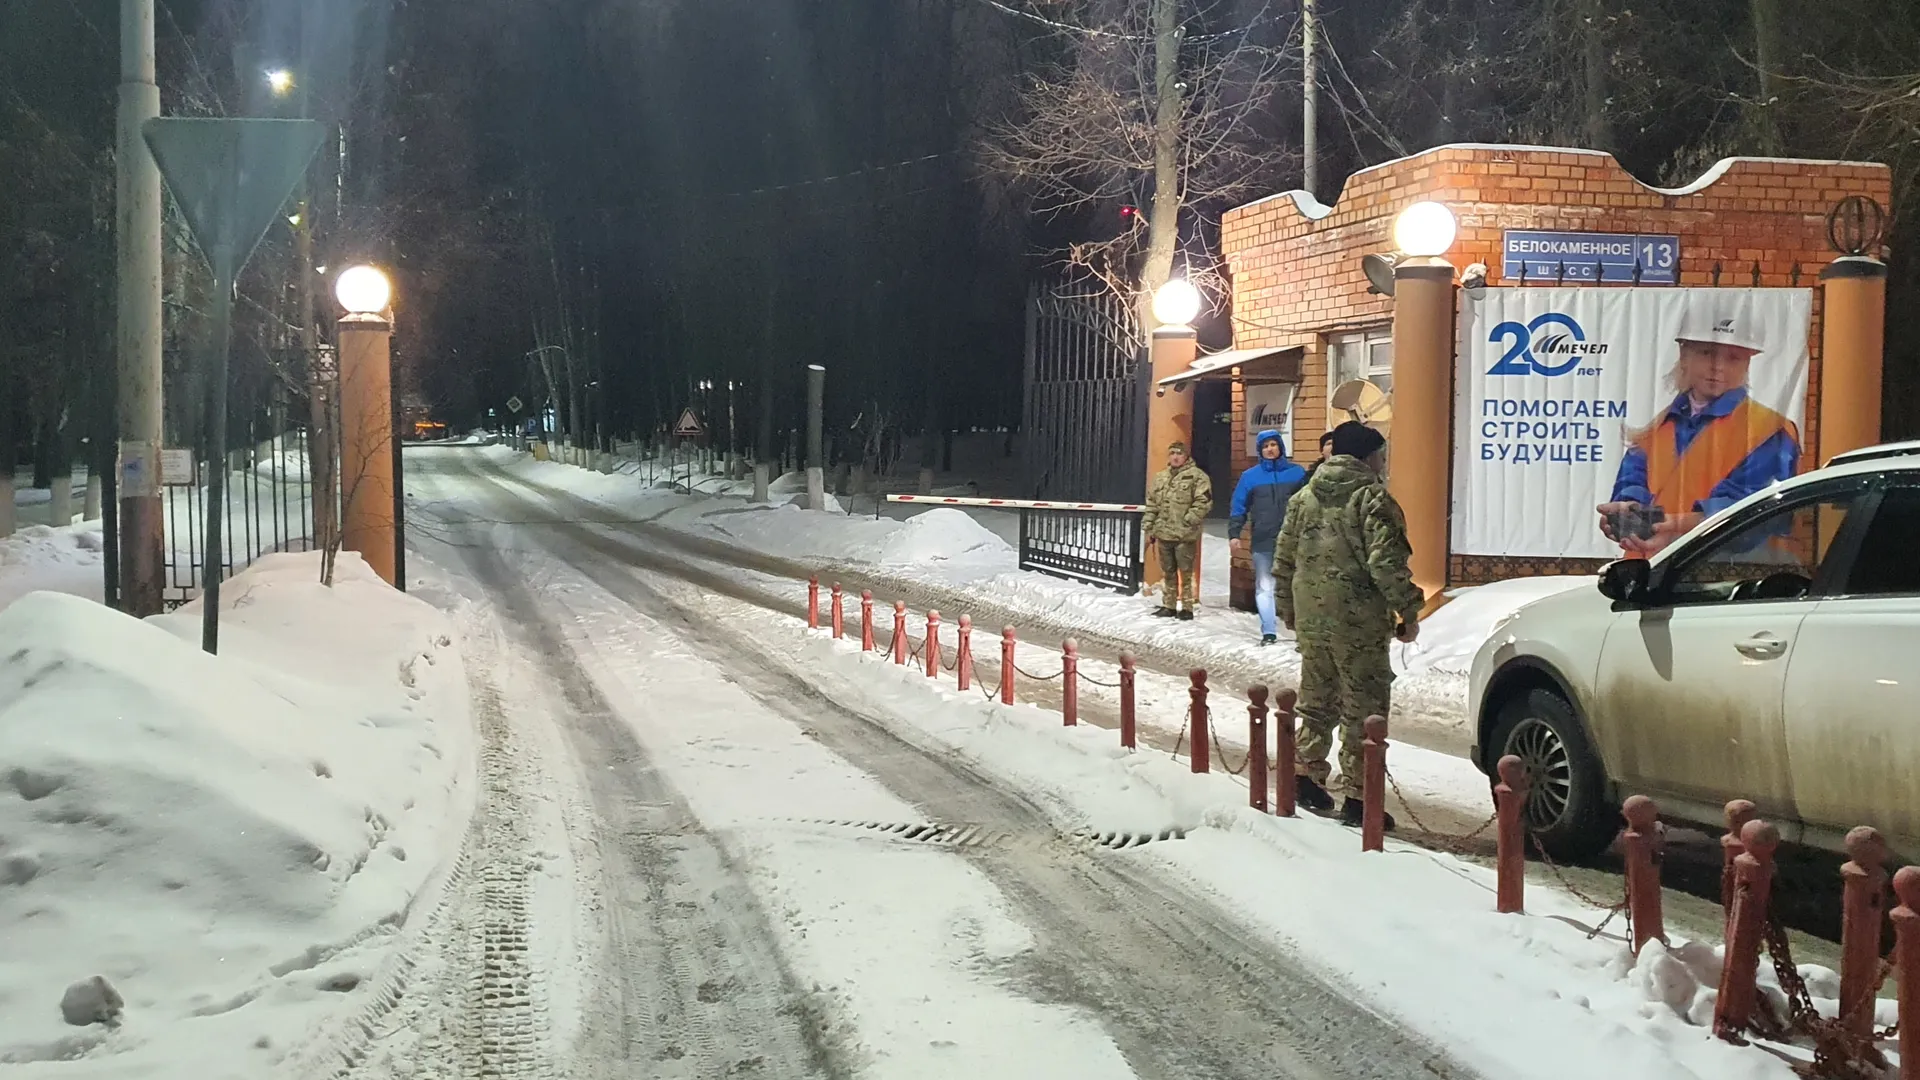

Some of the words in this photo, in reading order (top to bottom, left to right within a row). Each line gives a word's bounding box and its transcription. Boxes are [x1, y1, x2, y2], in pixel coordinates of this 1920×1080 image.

[1508, 240, 1631, 256] БЕЛОКАМЕННОЕ
[1642, 243, 1673, 267] 13
[1537, 266, 1602, 276] ШСС
[1485, 312, 1586, 377] 20
[1557, 344, 1608, 354] МЕЧЕЛ
[1577, 367, 1603, 376] лет
[1483, 399, 1627, 418] ПОМОГАЕМ
[1482, 421, 1600, 440] СТРОИТЬ
[1481, 443, 1603, 465] БУДУЩЕЕ
